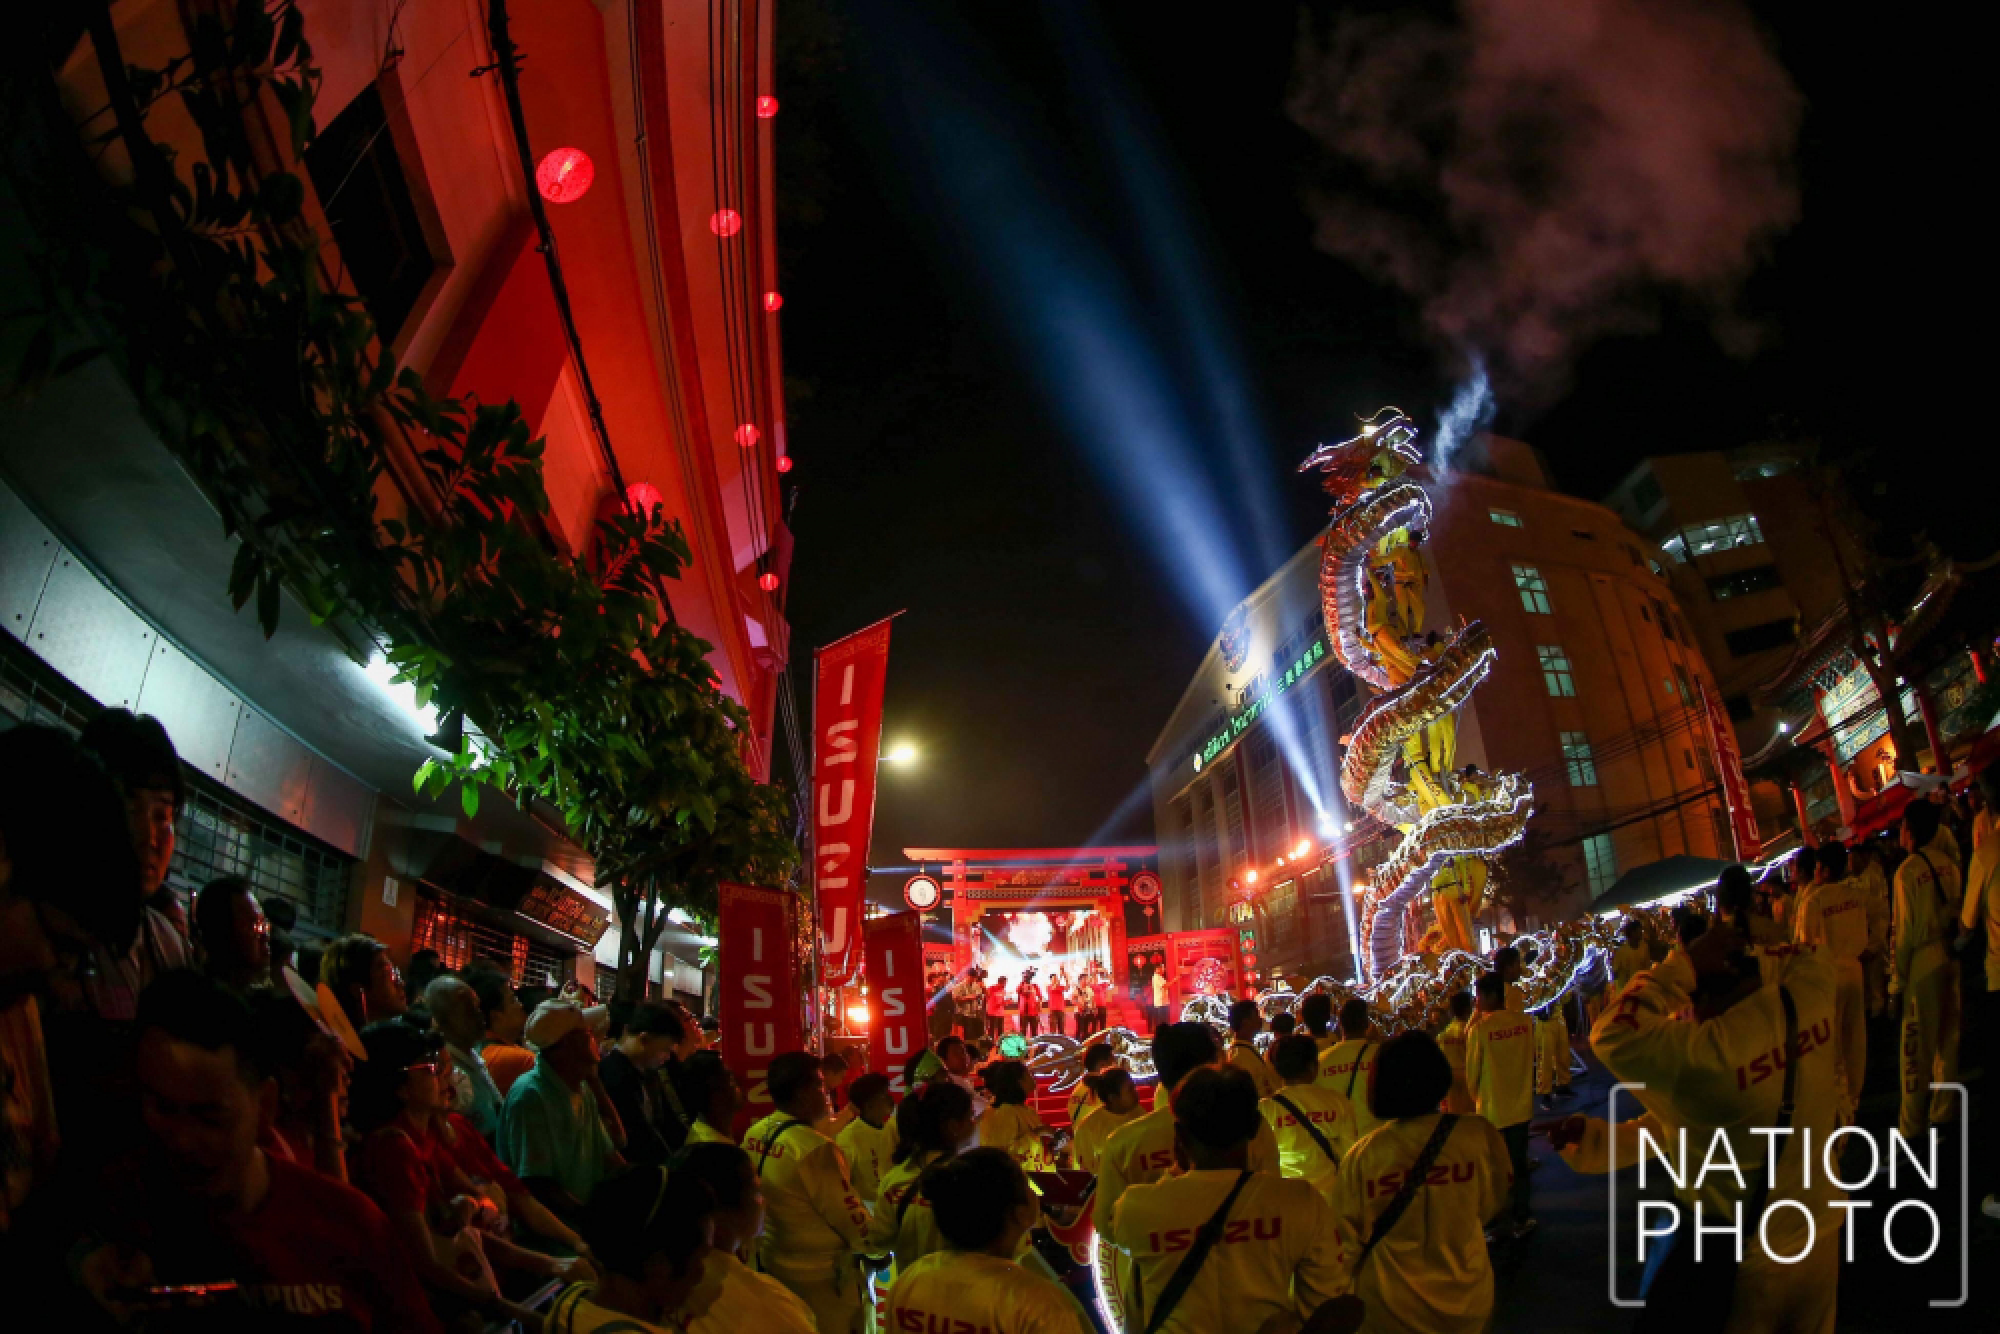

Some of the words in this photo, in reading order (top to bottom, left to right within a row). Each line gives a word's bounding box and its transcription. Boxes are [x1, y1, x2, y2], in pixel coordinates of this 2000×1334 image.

[818, 664, 860, 954] ISUZU
[743, 926, 776, 1112] ISUZ
[1905, 1002, 1919, 1094] ISUZU
[1277, 1109, 1337, 1128] ISZU
[1366, 1161, 1476, 1200] ISZU
[1149, 1217, 1282, 1254] ISZU
